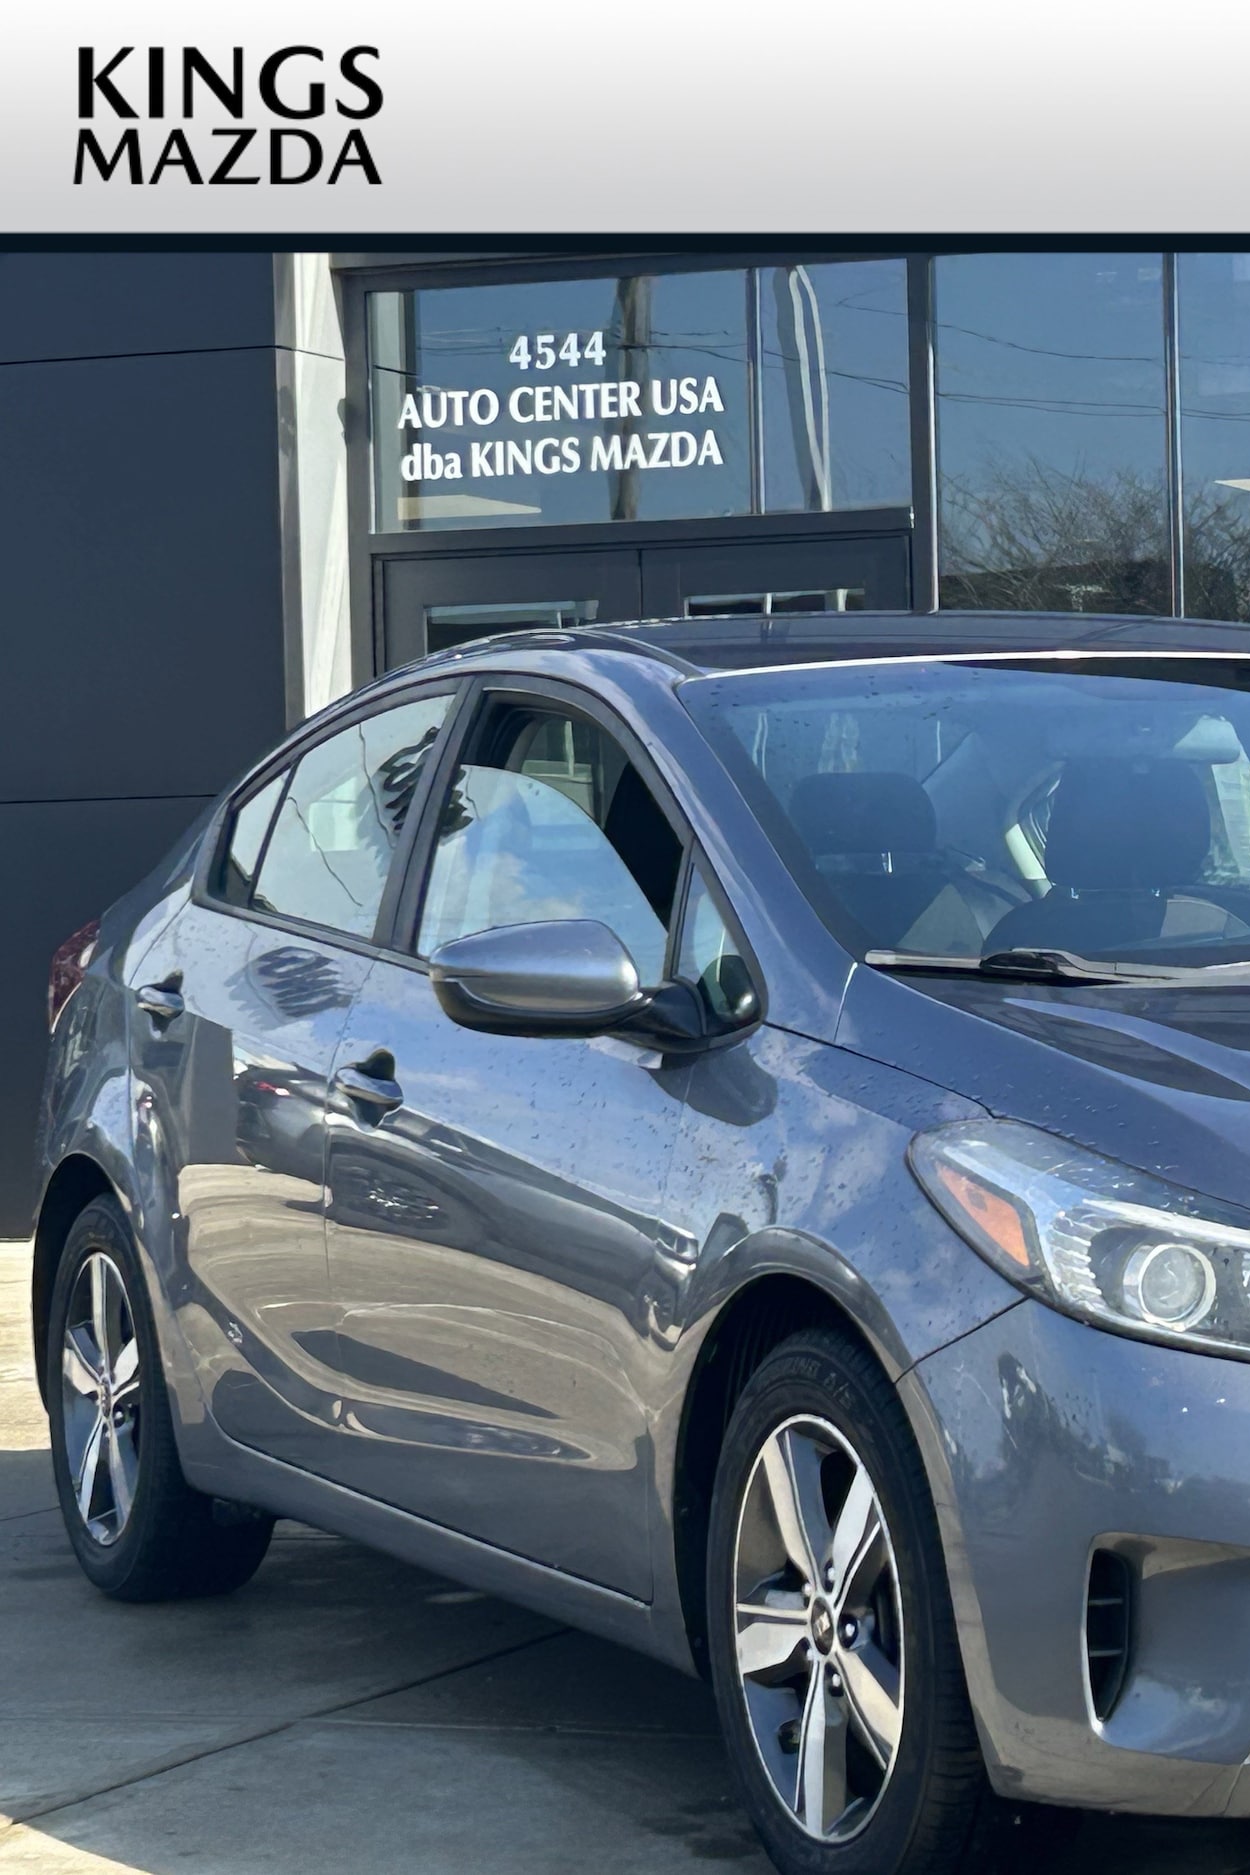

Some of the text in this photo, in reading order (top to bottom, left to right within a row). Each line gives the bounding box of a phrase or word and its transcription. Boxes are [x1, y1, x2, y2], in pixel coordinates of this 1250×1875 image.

[508, 331, 606, 370] 4544
[397, 376, 725, 429] AUTO CENTER USA
[401, 429, 724, 481] dba KINGS MAZDA
